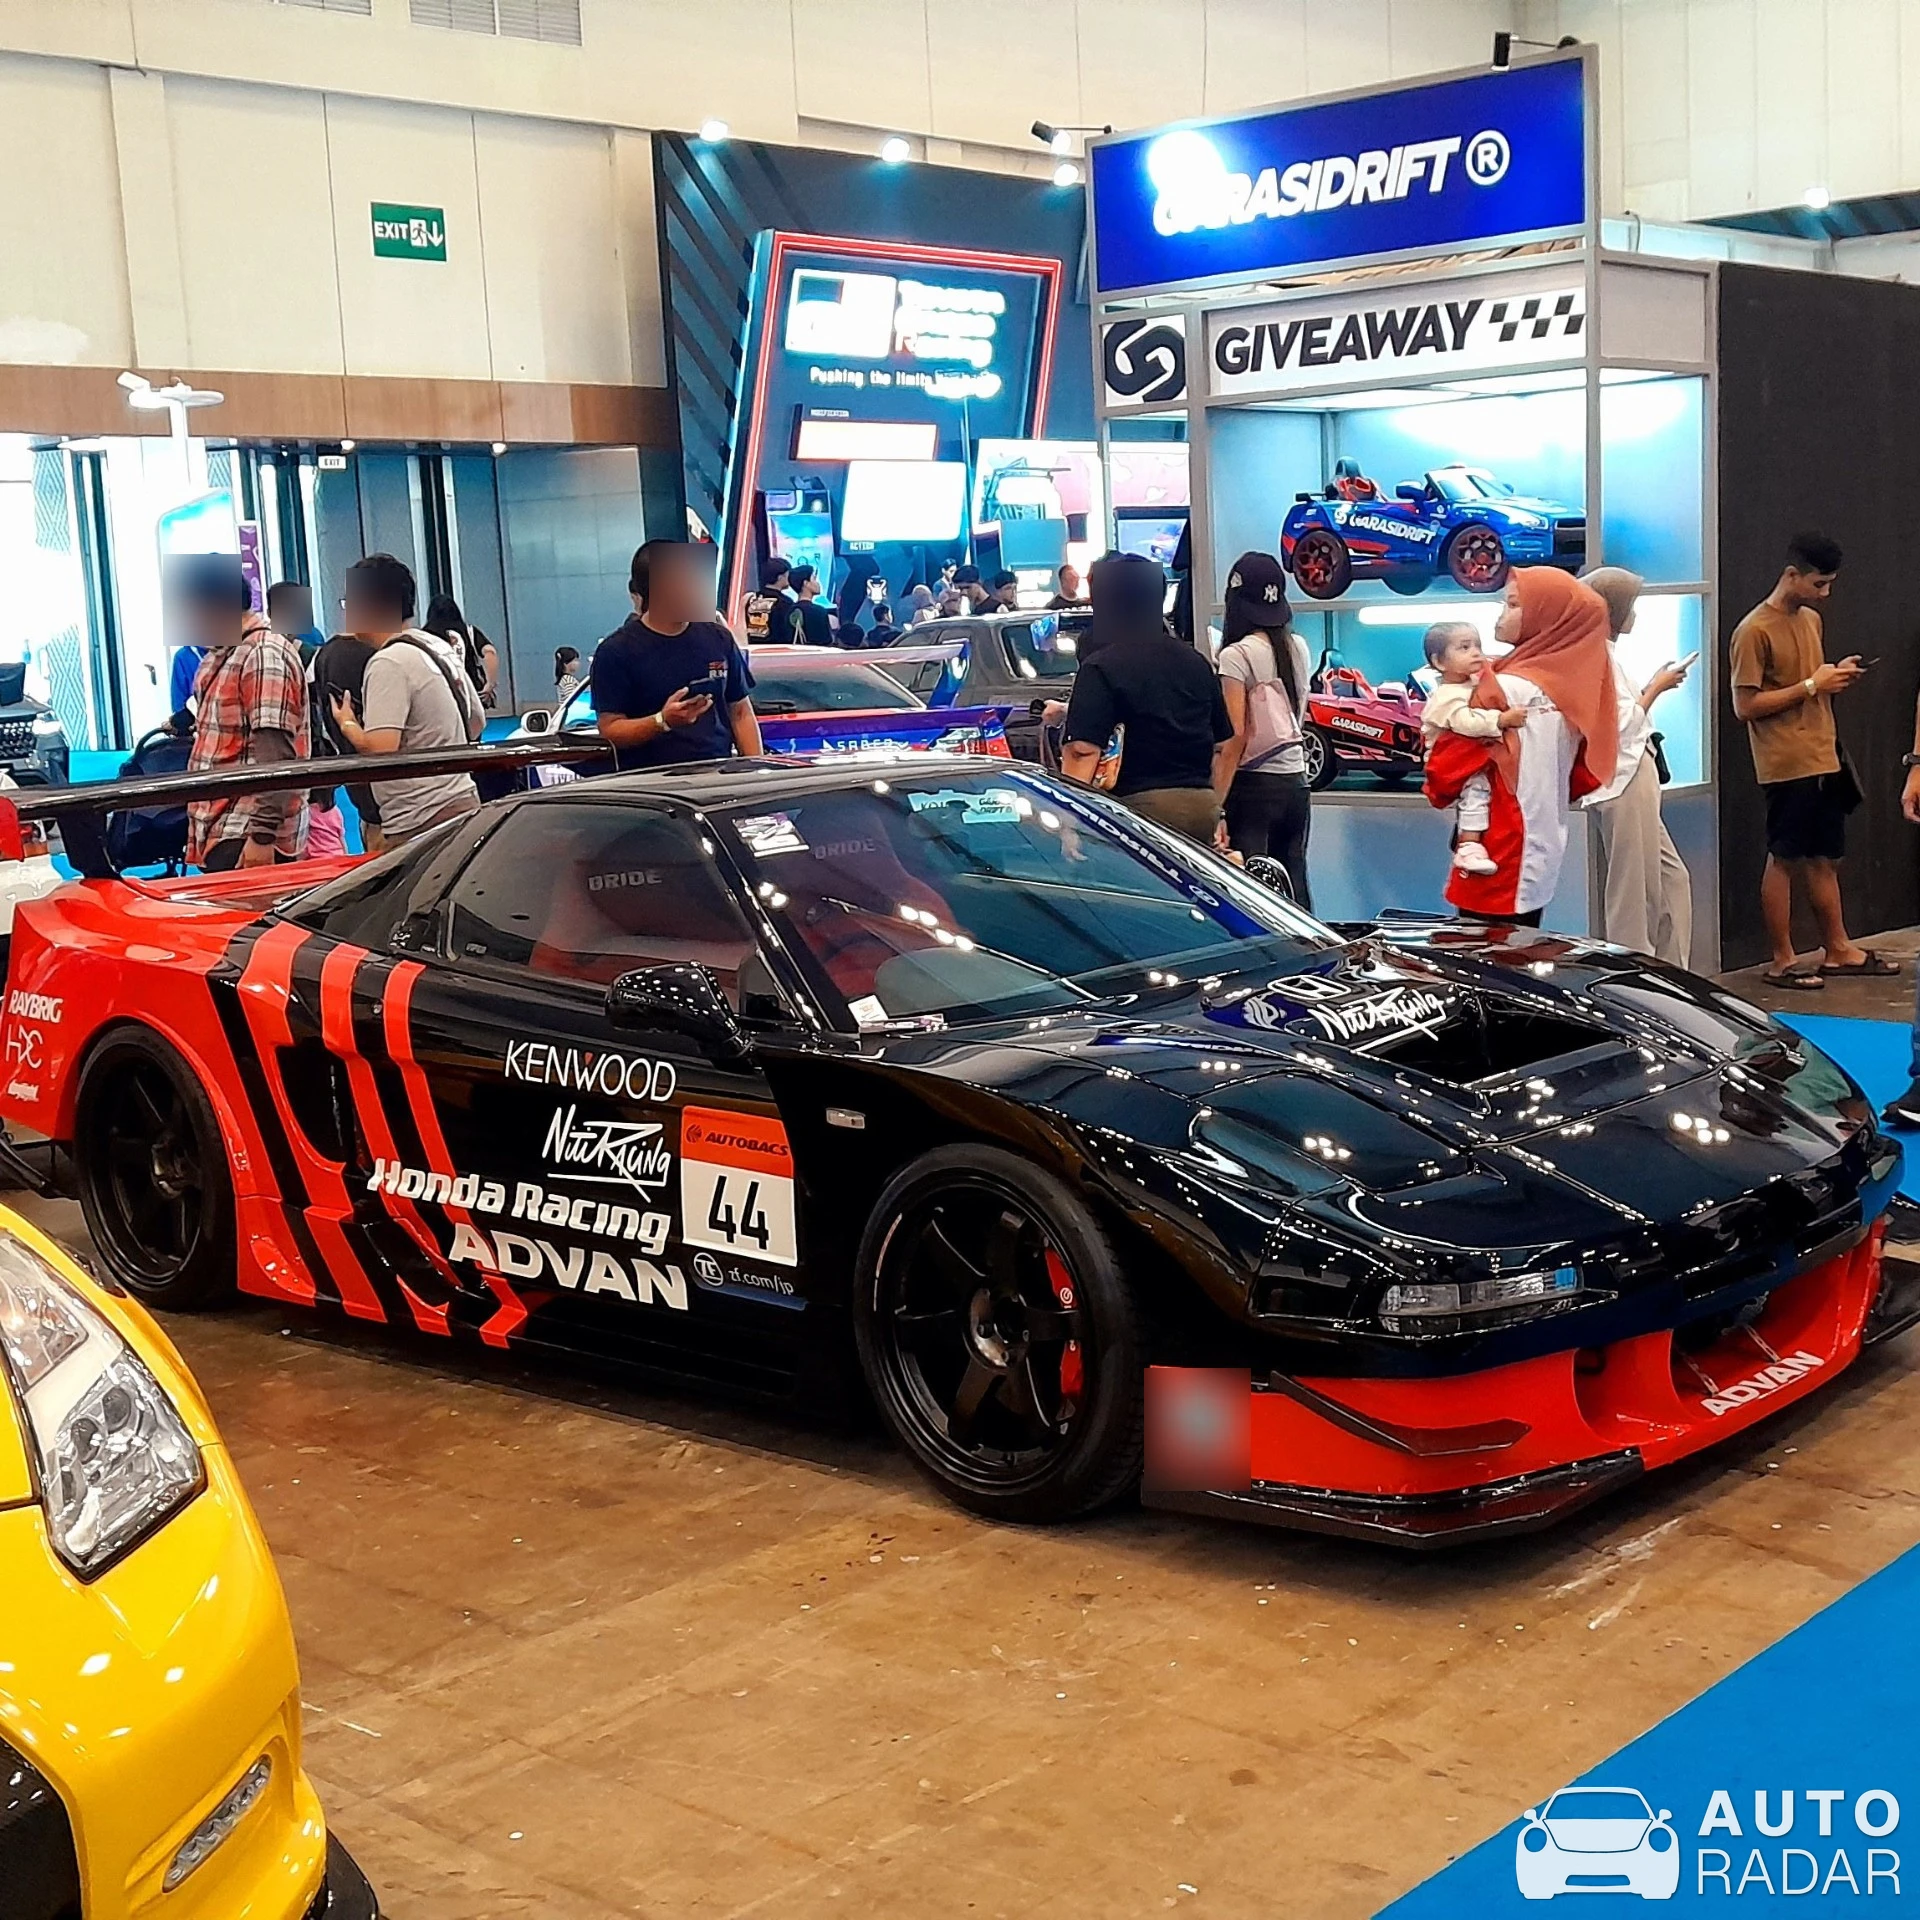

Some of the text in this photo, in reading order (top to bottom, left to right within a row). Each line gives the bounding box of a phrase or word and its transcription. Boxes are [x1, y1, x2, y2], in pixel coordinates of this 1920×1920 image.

[374, 221, 409, 240] EXIT
[1215, 299, 1485, 375] GIVEAWAY
[810, 366, 864, 389] Pushing
[870, 370, 891, 386] the
[324, 458, 340, 466] EXIT
[1002, 770, 1184, 884] RASIDRIFT
[8, 990, 63, 1023] RAYBRIG
[505, 1040, 677, 1102] KENWOOD
[705, 1132, 789, 1157] AUTOBACS
[367, 1158, 671, 1256] Honda Racing
[708, 1175, 770, 1250] 44
[449, 1223, 689, 1311] ADVAN
[728, 1267, 794, 1295] zf.com/jp
[1700, 1350, 1825, 1416] ADVAN
